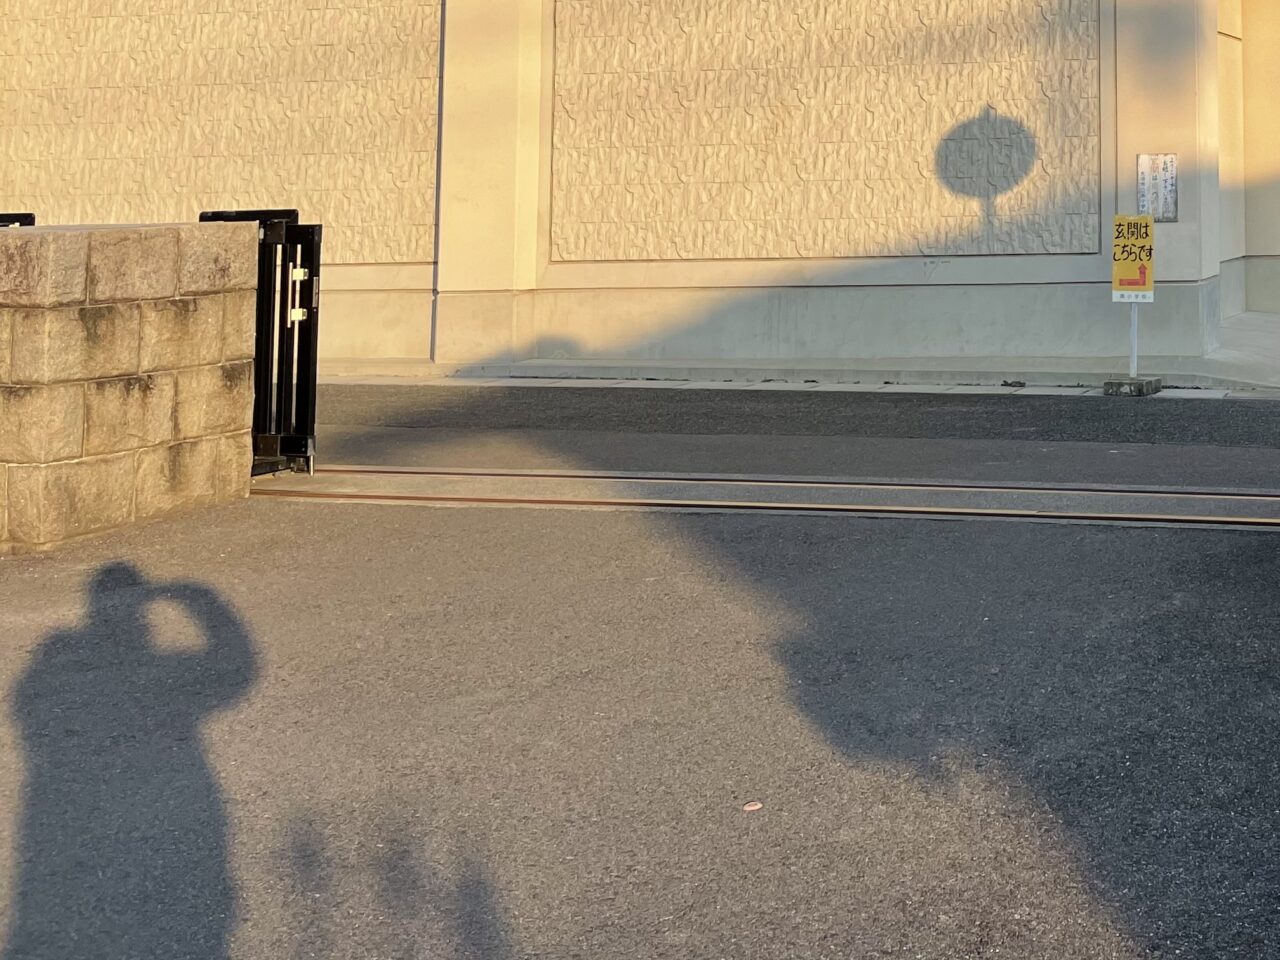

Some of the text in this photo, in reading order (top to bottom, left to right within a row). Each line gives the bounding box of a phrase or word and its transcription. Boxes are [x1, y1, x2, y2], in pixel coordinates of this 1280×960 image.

[1114, 222, 1150, 240] 玄関は
[1113, 243, 1154, 262] こちらです
